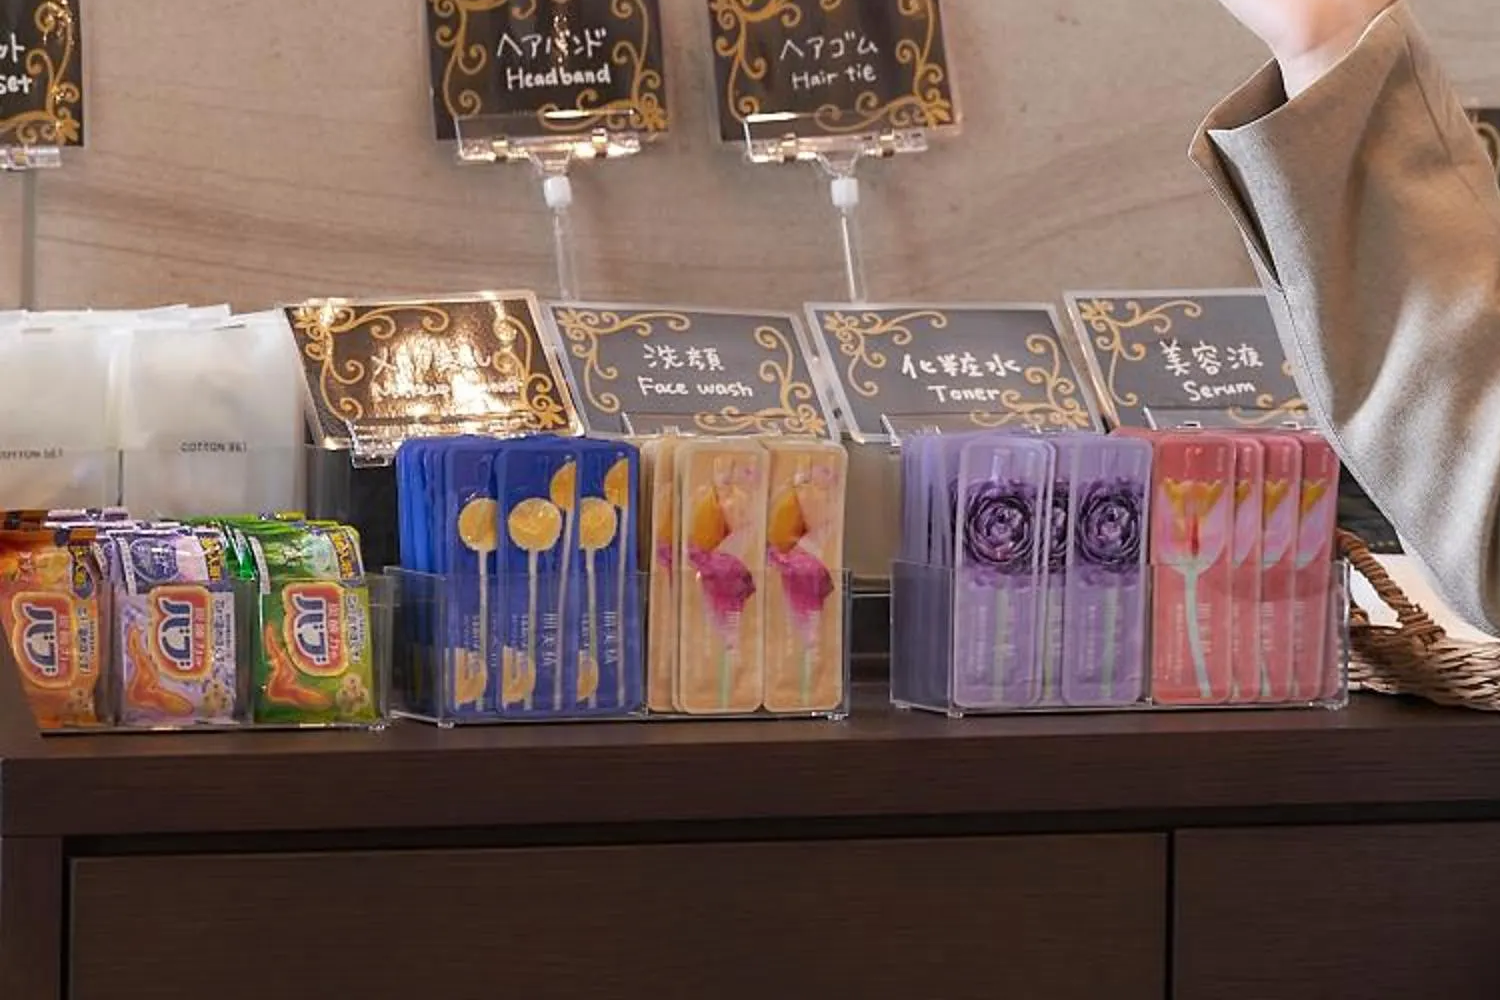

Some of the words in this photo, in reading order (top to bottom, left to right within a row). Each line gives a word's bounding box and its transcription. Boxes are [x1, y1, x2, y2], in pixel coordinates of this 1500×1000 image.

[779, 30, 878, 61] ヘアゴム
[505, 62, 611, 91] Headband
[791, 70, 839, 90] Hair
[844, 63, 877, 83] tie
[642, 343, 726, 372] 洗顔
[901, 351, 1022, 380] 化粧水
[1159, 336, 1264, 377] 美容液
[637, 376, 689, 397] Face
[696, 381, 754, 397] wash
[927, 384, 1001, 403] Toner
[1182, 380, 1256, 402] Serum
[159, 598, 193, 670] バブ
[292, 593, 329, 665] バブ
